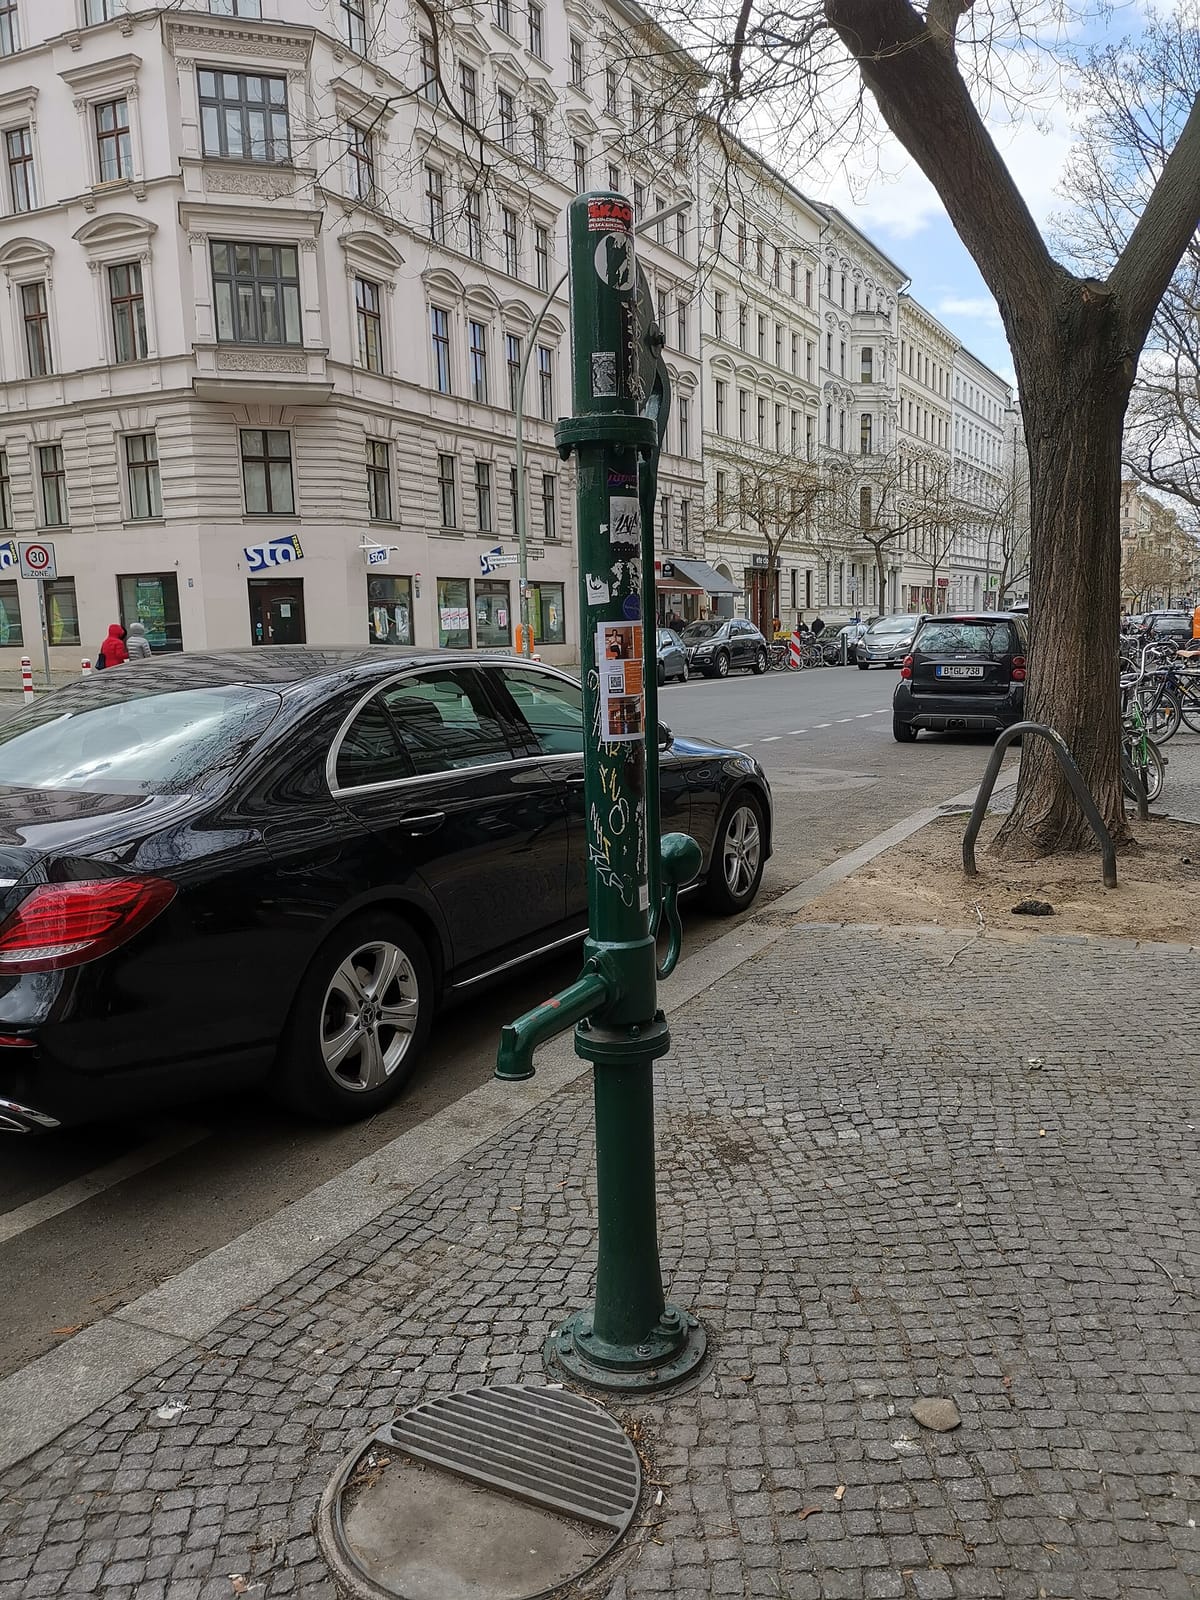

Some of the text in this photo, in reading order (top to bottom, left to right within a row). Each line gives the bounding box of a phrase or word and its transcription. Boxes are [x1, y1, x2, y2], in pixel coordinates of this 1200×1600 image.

[246, 543, 297, 568] sta
[291, 535, 303, 559] TRAVEL
[31, 551, 45, 563] 30
[954, 667, 964, 675] GL
[966, 667, 980, 675] 738
